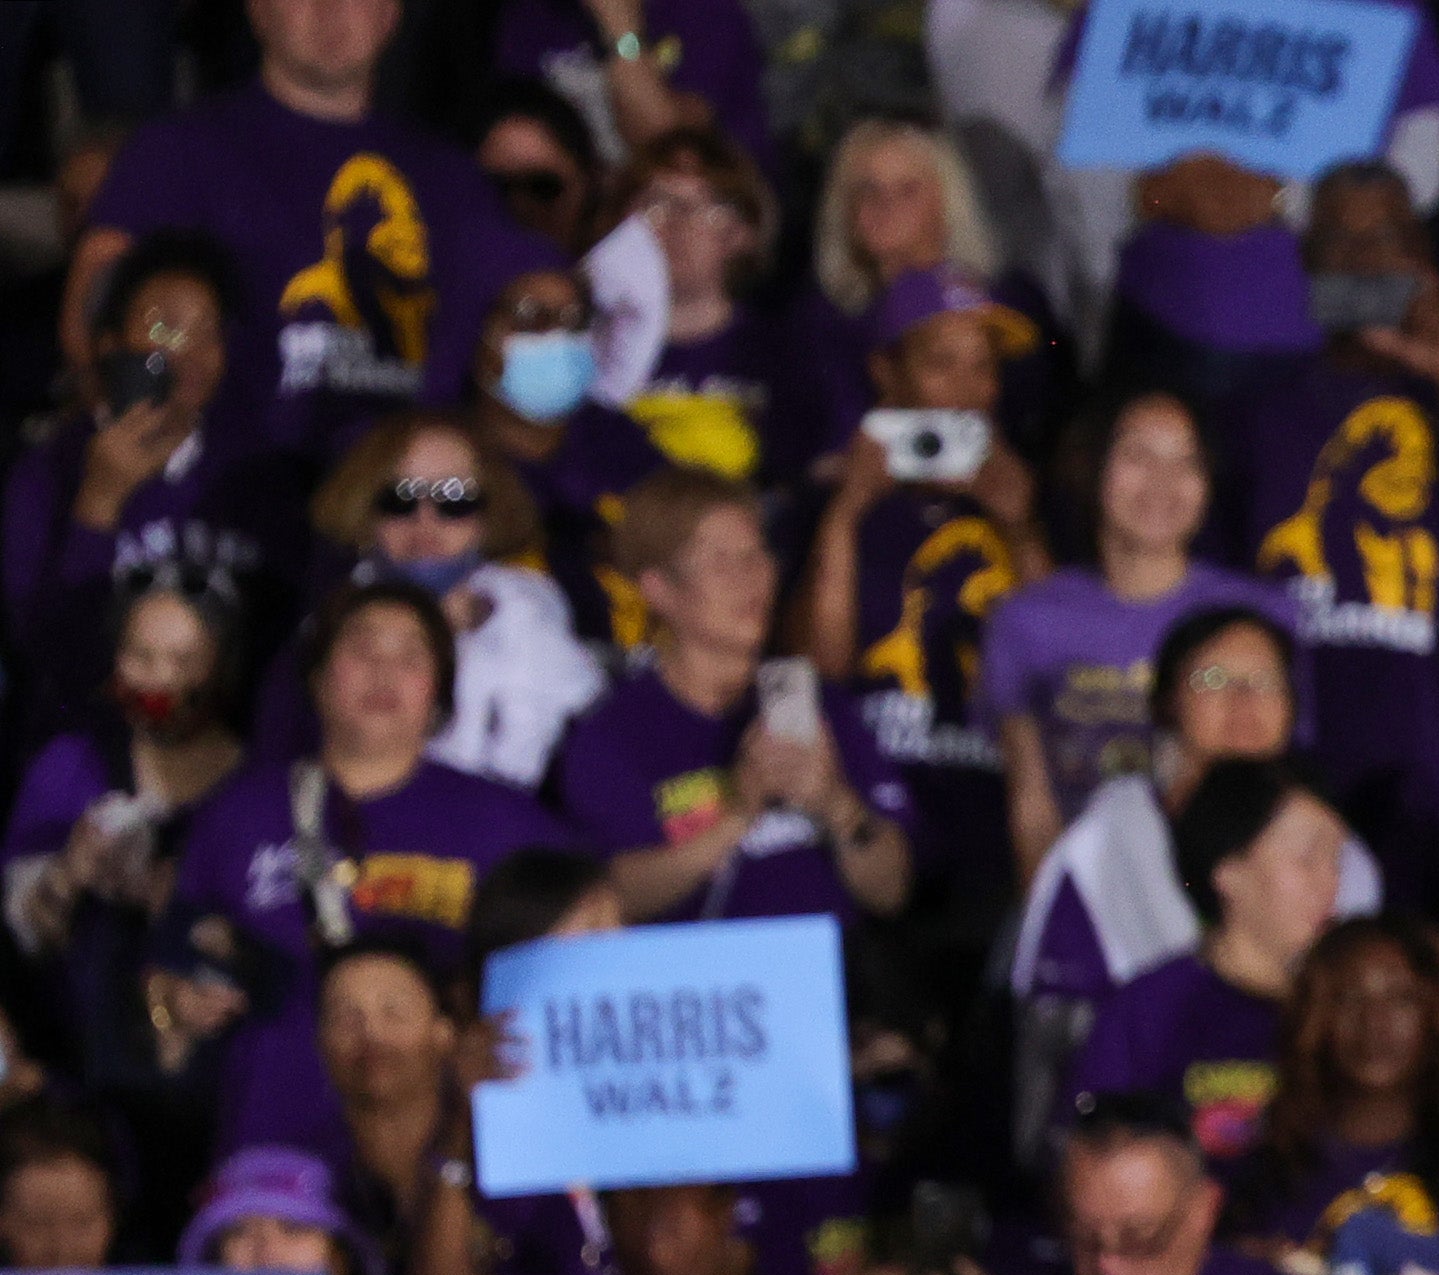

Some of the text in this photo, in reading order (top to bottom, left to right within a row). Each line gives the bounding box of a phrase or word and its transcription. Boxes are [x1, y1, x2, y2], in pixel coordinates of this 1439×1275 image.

[1120, 8, 1350, 102] HARRIS
[1146, 88, 1298, 138] WALZ
[545, 982, 769, 1072] HARRIS
[584, 1065, 736, 1122] WALZ
